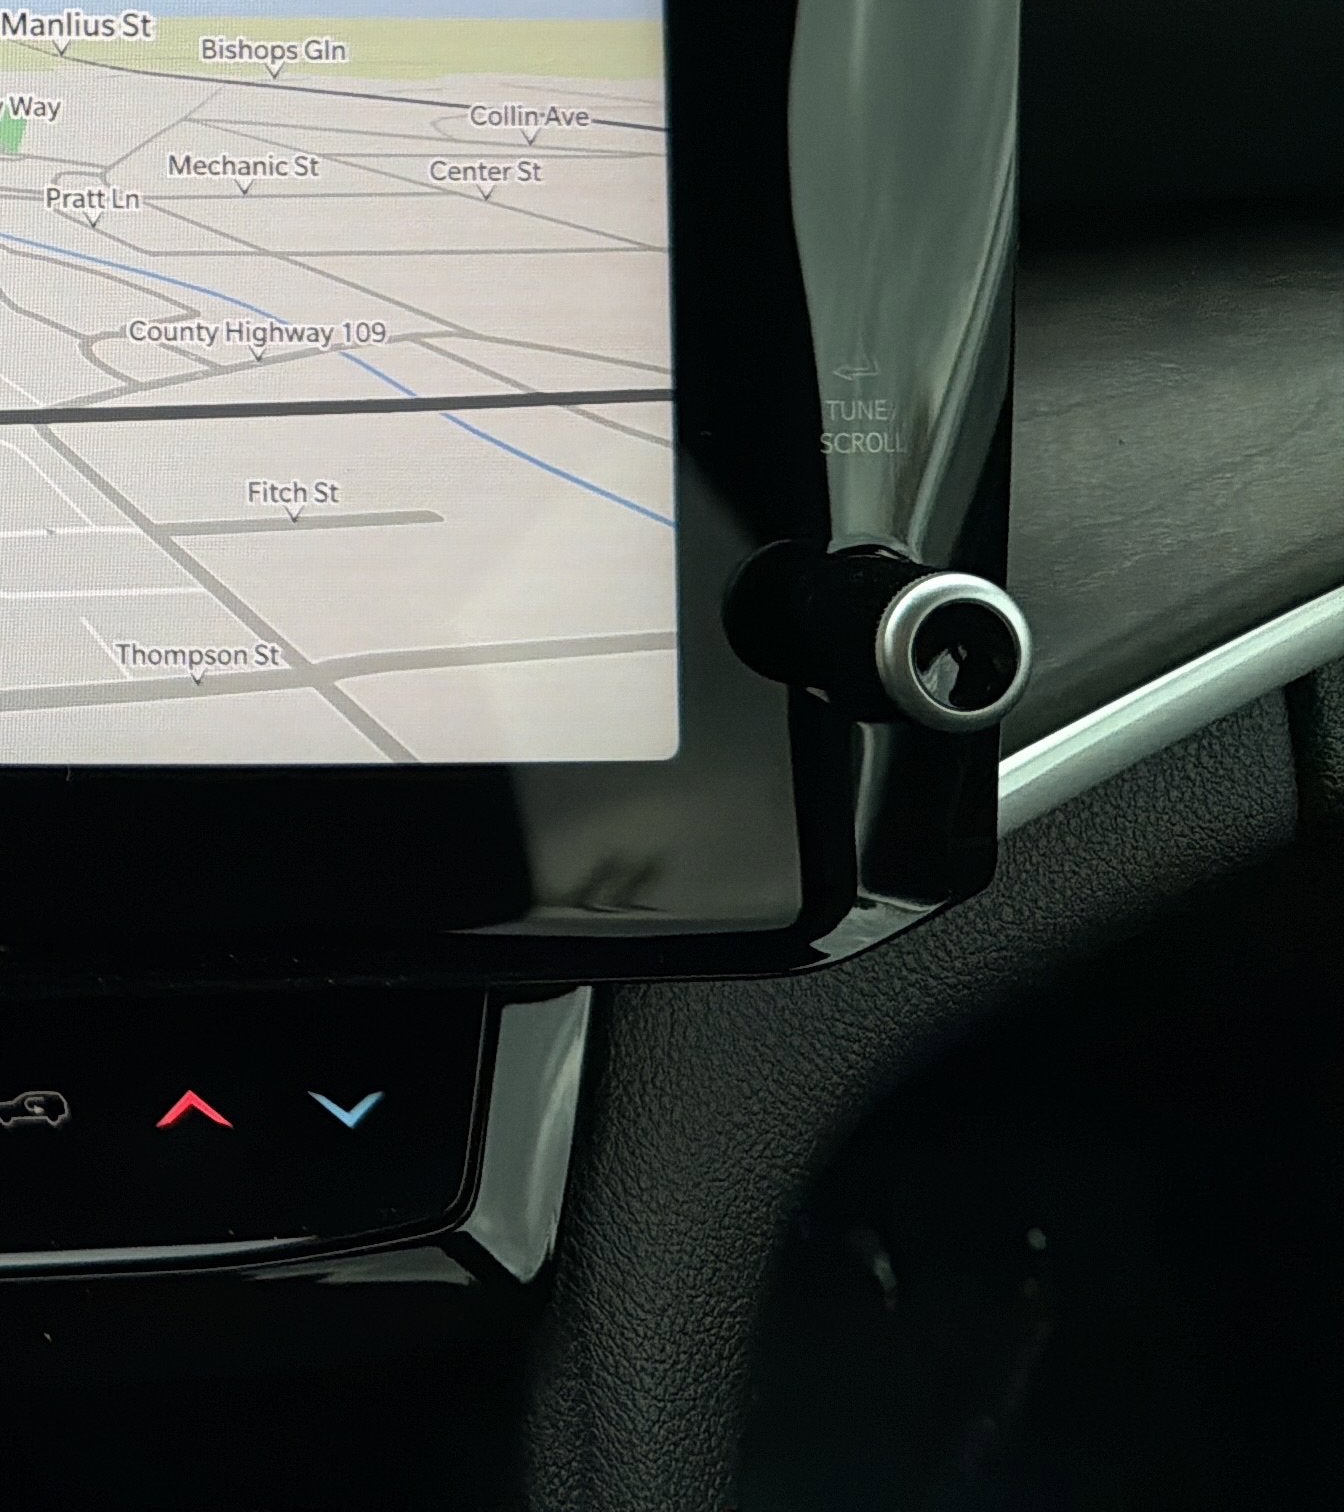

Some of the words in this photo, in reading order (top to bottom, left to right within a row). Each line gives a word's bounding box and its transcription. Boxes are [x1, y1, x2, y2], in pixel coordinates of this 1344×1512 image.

[0, 10, 117, 39] Manlius
[122, 11, 152, 39] St
[201, 37, 299, 66] Bishops
[305, 37, 347, 63] Gln
[8, 96, 61, 123] Way
[470, 103, 540, 129] Collin
[544, 103, 591, 129] Ave
[167, 154, 288, 179] Mechanic
[293, 153, 321, 177] St
[426, 157, 510, 184] Center
[513, 157, 543, 182] St
[45, 186, 105, 211] Pratt
[110, 187, 141, 211] Ln
[129, 319, 219, 350] County
[225, 319, 337, 350] Highway
[342, 321, 387, 346] 109
[247, 480, 307, 505] Fitch
[313, 481, 340, 504] St
[116, 642, 248, 672] Thompson
[249, 642, 280, 669] St
